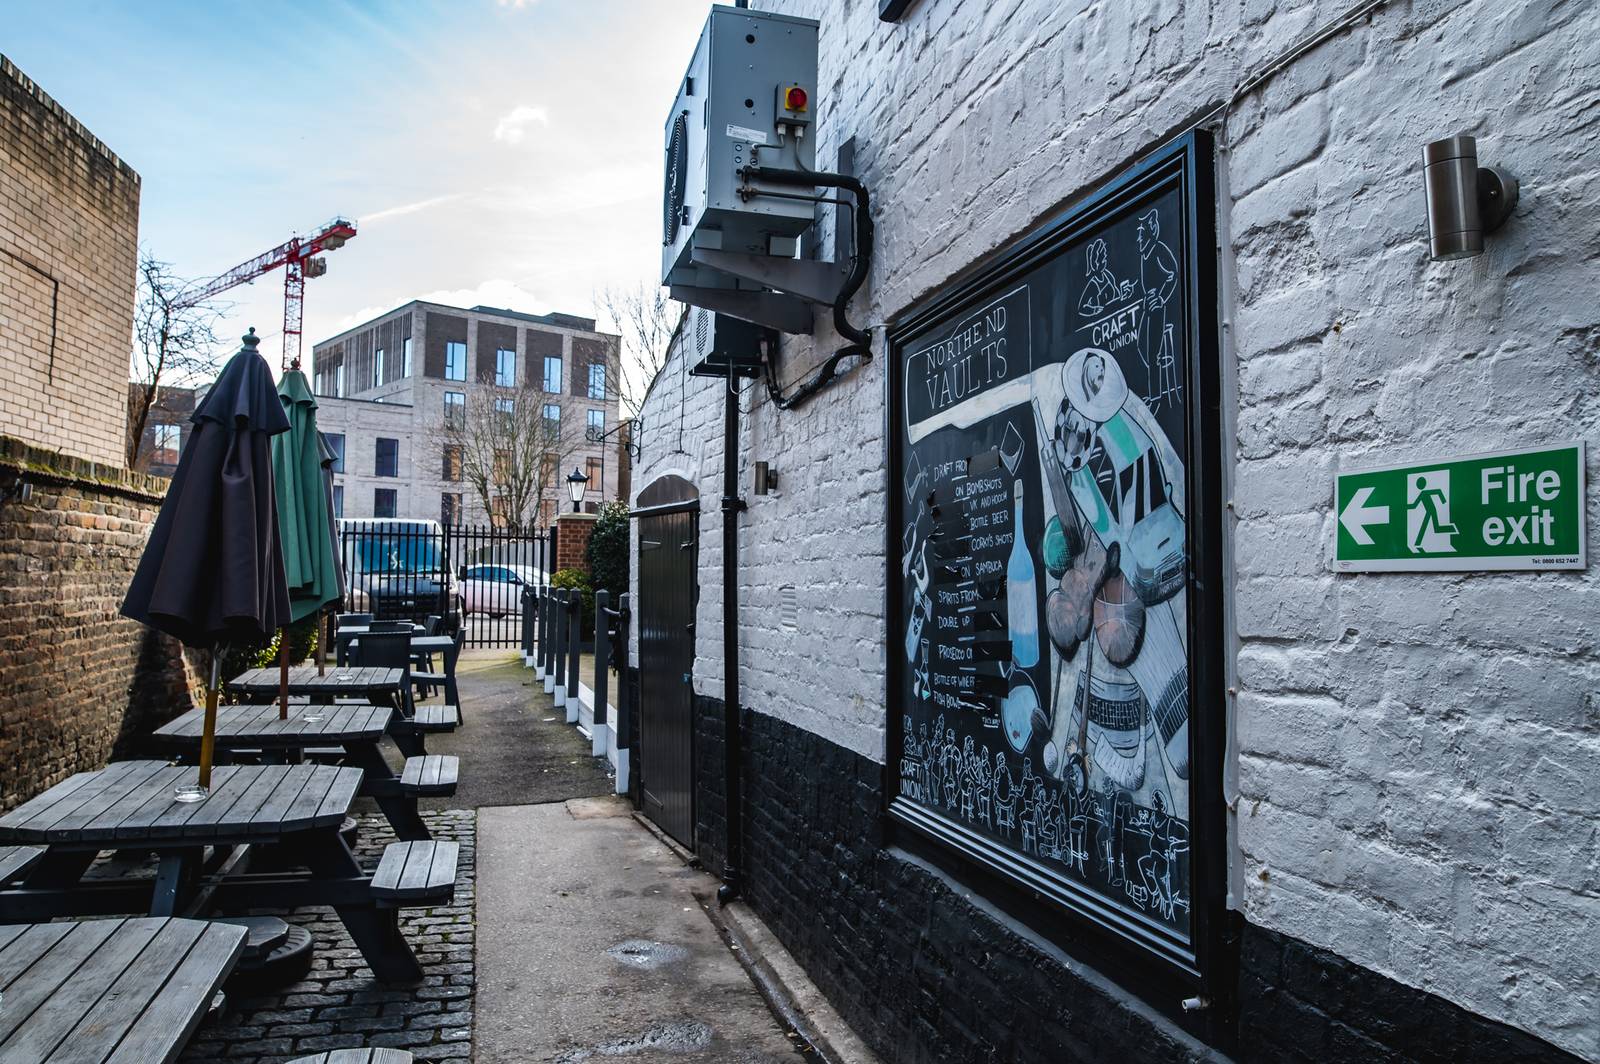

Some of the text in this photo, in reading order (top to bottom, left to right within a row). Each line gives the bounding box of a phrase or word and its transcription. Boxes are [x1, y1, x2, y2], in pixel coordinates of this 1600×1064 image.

[1092, 305, 1140, 346] CRAFT
[1109, 329, 1139, 352] UNION
[926, 337, 1007, 409] VAULTS
[934, 462, 954, 482] DRAFT
[955, 484, 964, 497] ON
[1481, 465, 1561, 505] Fire
[991, 509, 1009, 525] BEER
[1482, 505, 1555, 546] exit
[995, 532, 1014, 546] SHOTS
[961, 560, 1003, 579] ON SAMBUCA
[900, 758, 920, 778] CRAFT
[900, 778, 923, 801] UNION
